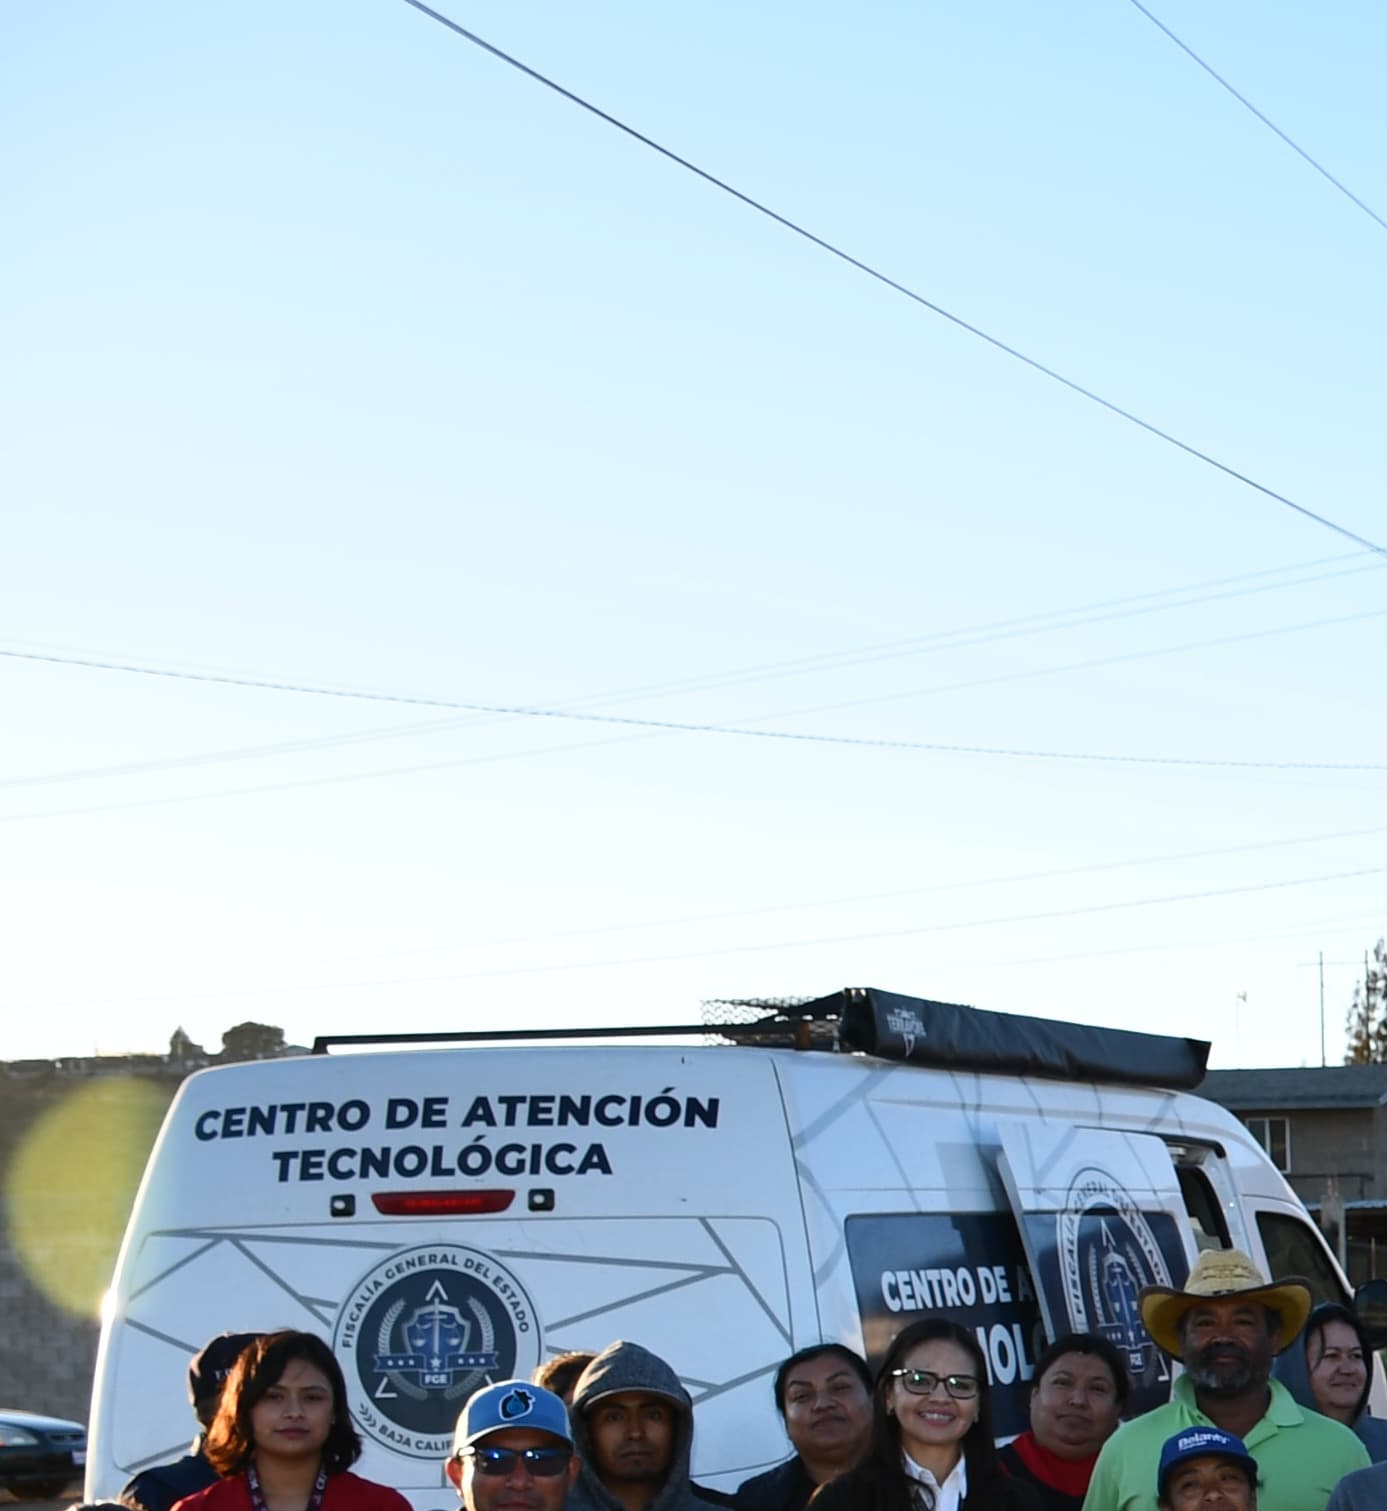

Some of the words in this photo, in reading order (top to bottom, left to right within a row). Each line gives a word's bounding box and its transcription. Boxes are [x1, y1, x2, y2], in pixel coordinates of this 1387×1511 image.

[194, 1099, 371, 1142] CENTRO
[385, 1096, 449, 1131] DE
[461, 1086, 720, 1129] ATENCIÓN
[272, 1135, 613, 1183] TECNOLÓGICA
[341, 1279, 383, 1349] FISCALÍA
[384, 1253, 459, 1280] GENERAL
[463, 1257, 491, 1279] DEL
[492, 1275, 530, 1334] ESTADO
[881, 1266, 977, 1312] CENTRO
[976, 1265, 1012, 1304] DE
[424, 1373, 448, 1385] FGE
[378, 1423, 412, 1448] BAJA
[415, 1439, 453, 1452] CALIF
